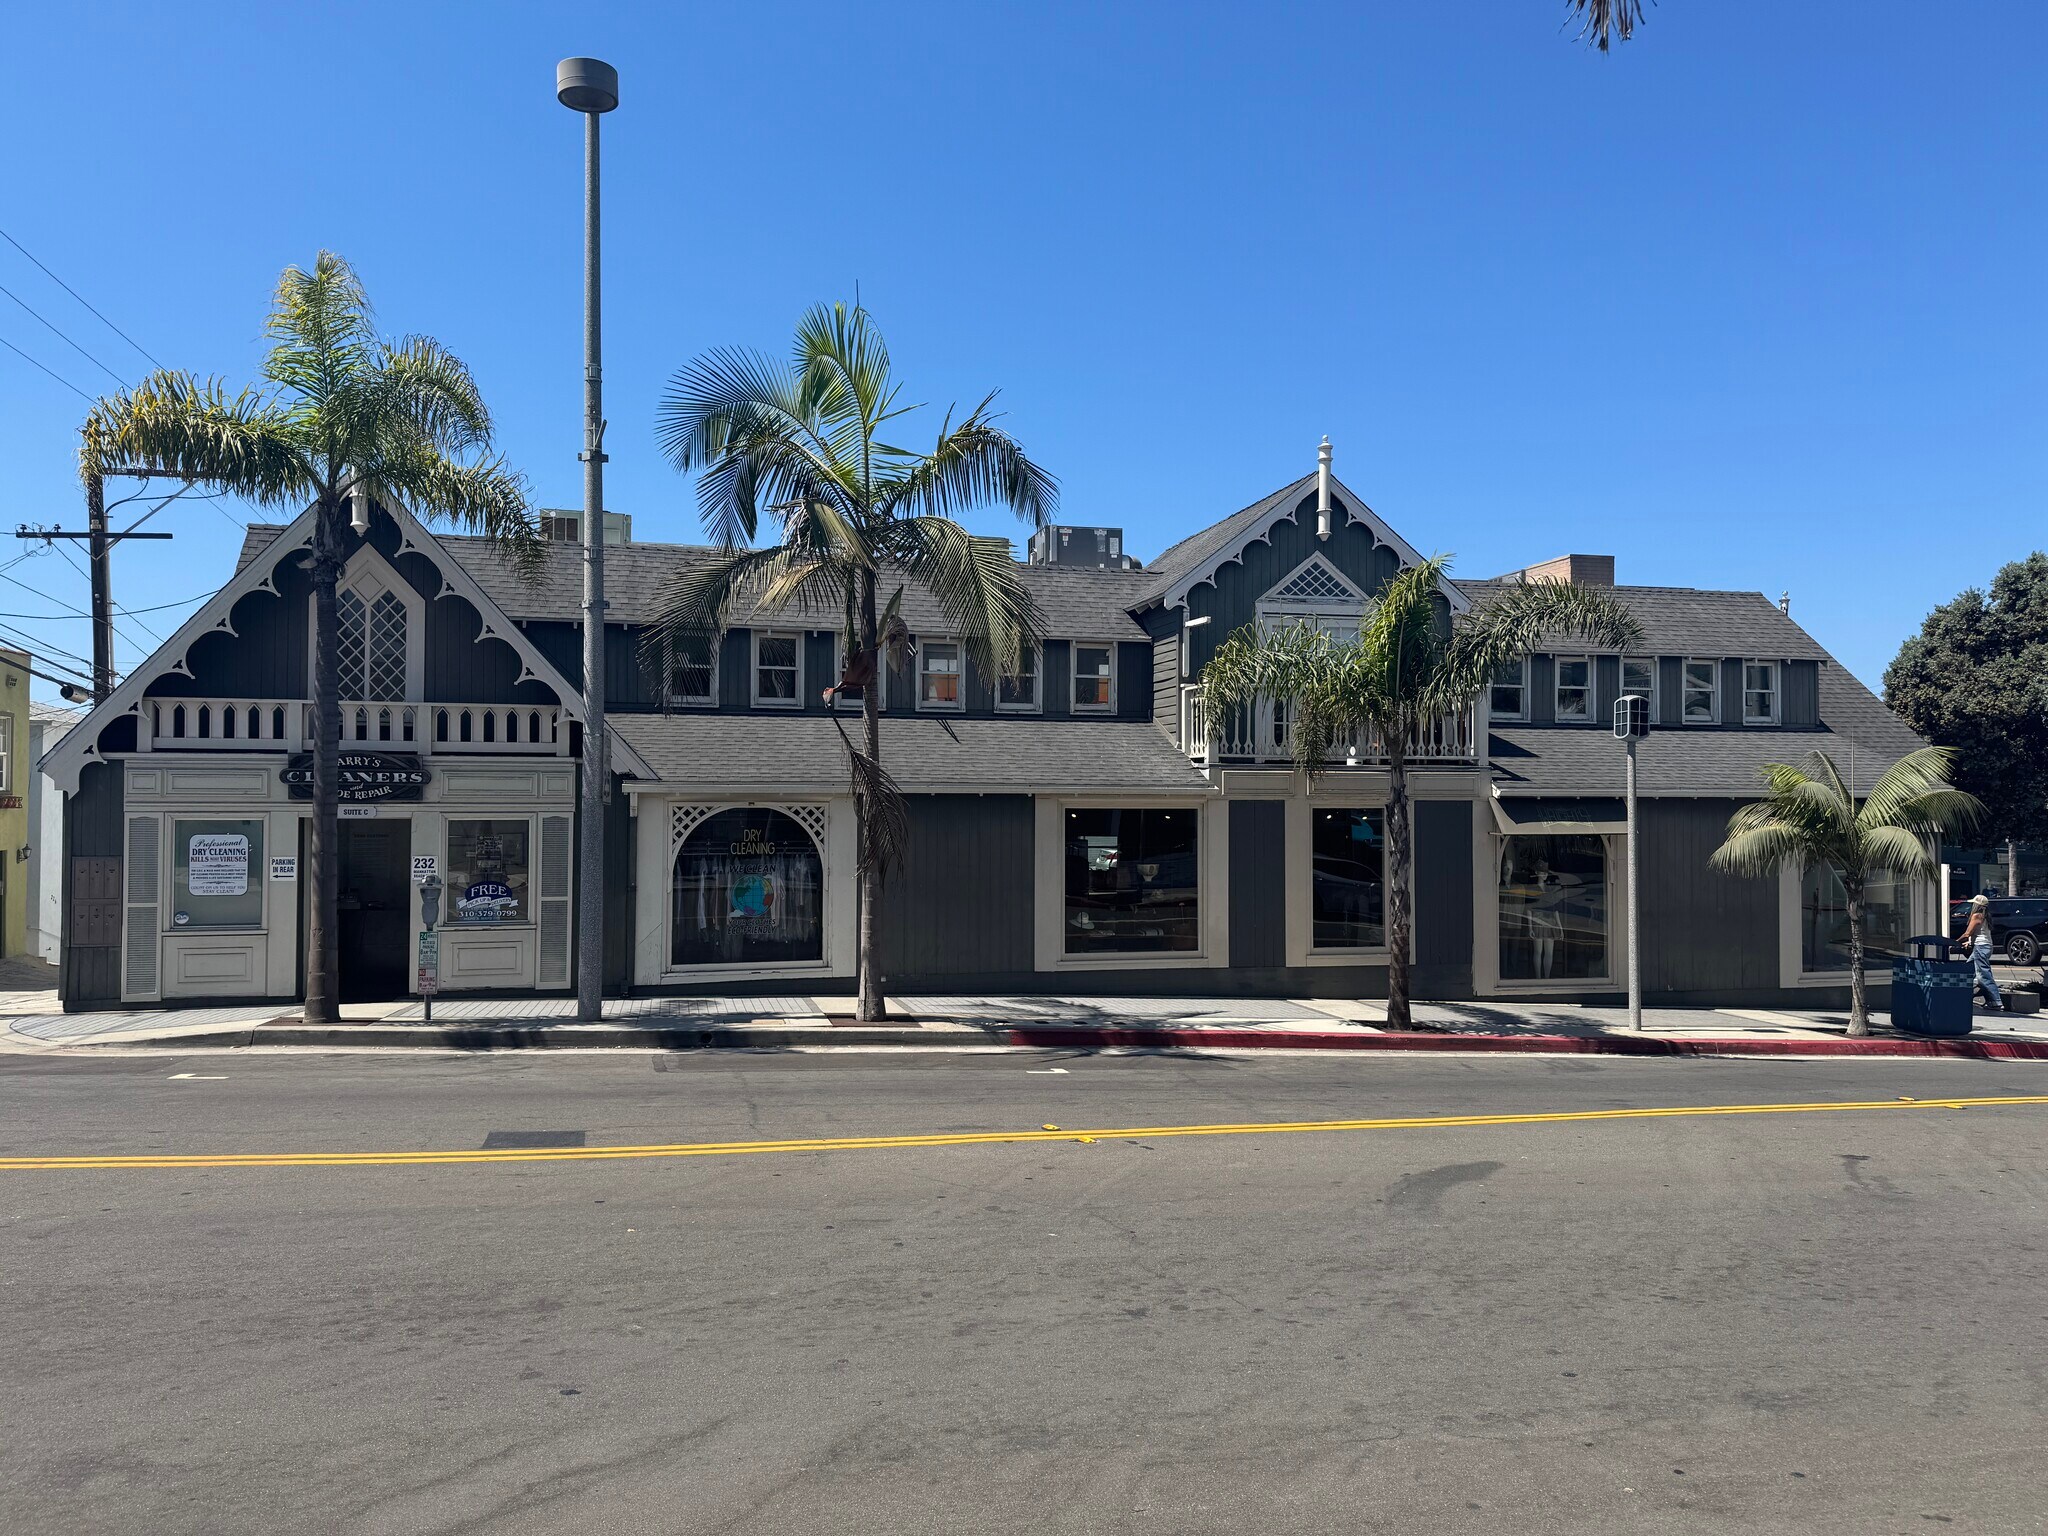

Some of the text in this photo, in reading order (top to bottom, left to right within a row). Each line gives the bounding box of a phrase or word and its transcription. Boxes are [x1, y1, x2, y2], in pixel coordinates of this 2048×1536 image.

[338, 756, 381, 768] ARRY'S
[286, 771, 422, 782] CLANERS
[350, 782, 364, 791] and
[354, 785, 393, 800] REPAIR
[343, 808, 369, 816] SUITE C
[743, 829, 762, 842] DRY
[194, 837, 243, 850] Professional
[730, 842, 776, 855] CLEANING
[192, 848, 247, 856] DRY CLEANING
[220, 855, 247, 863] VIRUSES
[271, 858, 296, 866] PARKING
[414, 858, 434, 868] 232
[745, 864, 777, 874] CLEAN
[471, 884, 507, 896] FREE
[420, 932, 427, 940] 24
